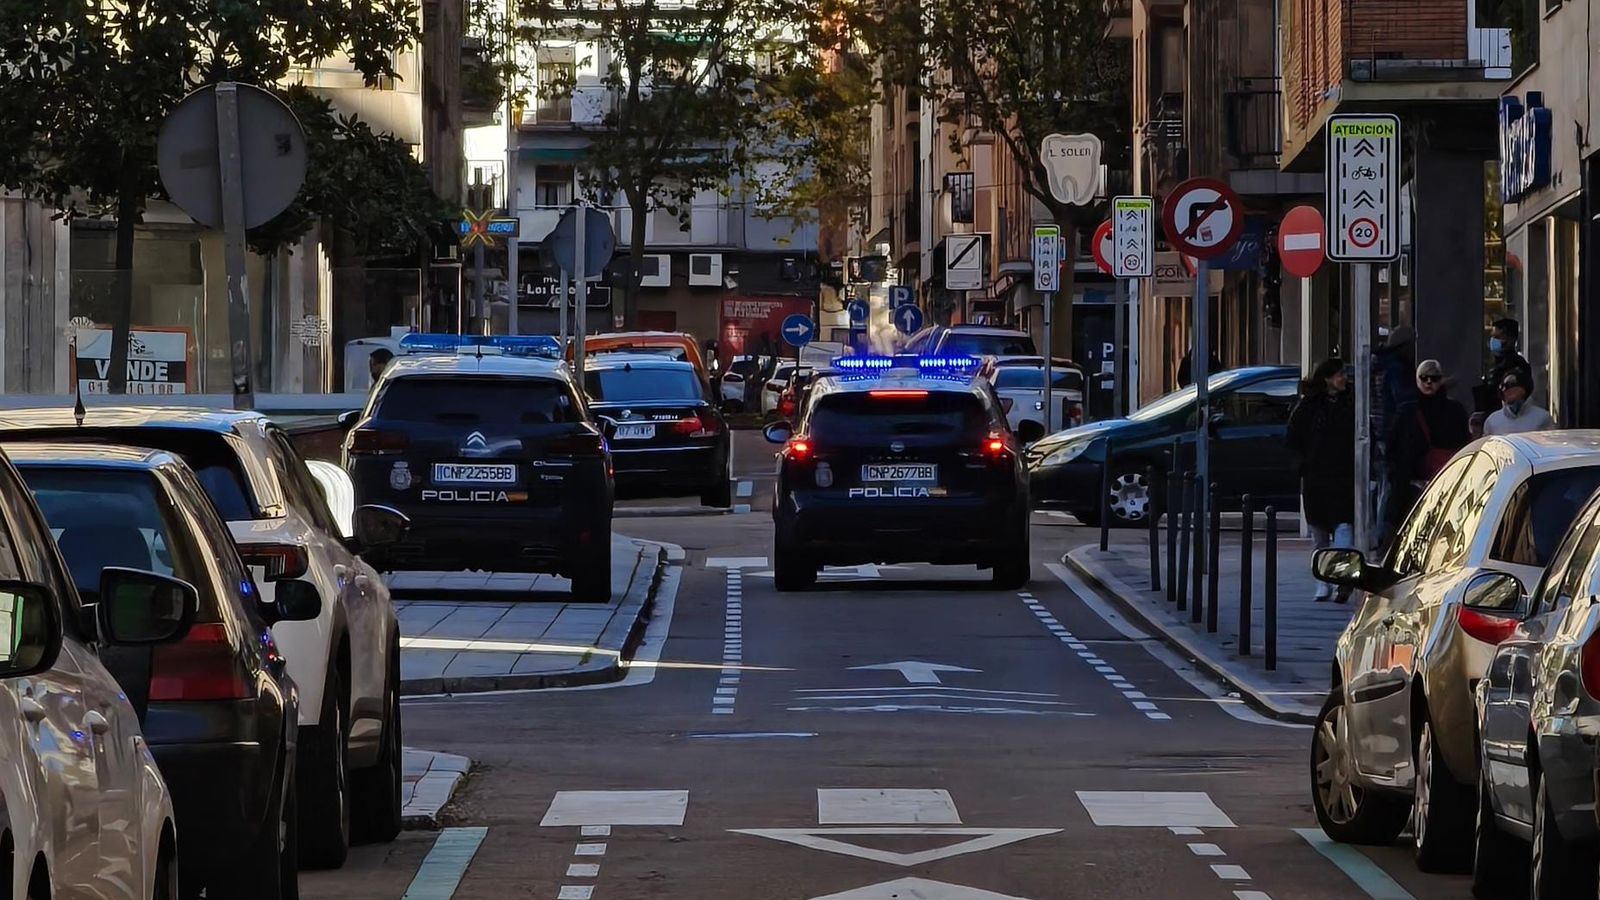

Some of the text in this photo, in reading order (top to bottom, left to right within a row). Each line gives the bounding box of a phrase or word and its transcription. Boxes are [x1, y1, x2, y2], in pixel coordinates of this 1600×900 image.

[1355, 228, 1372, 238] 20
[894, 288, 909, 308] P
[1102, 342, 1114, 358] P
[95, 359, 168, 381] VNDE
[421, 490, 509, 502] POLICIA
[849, 486, 930, 498] POLICIA
